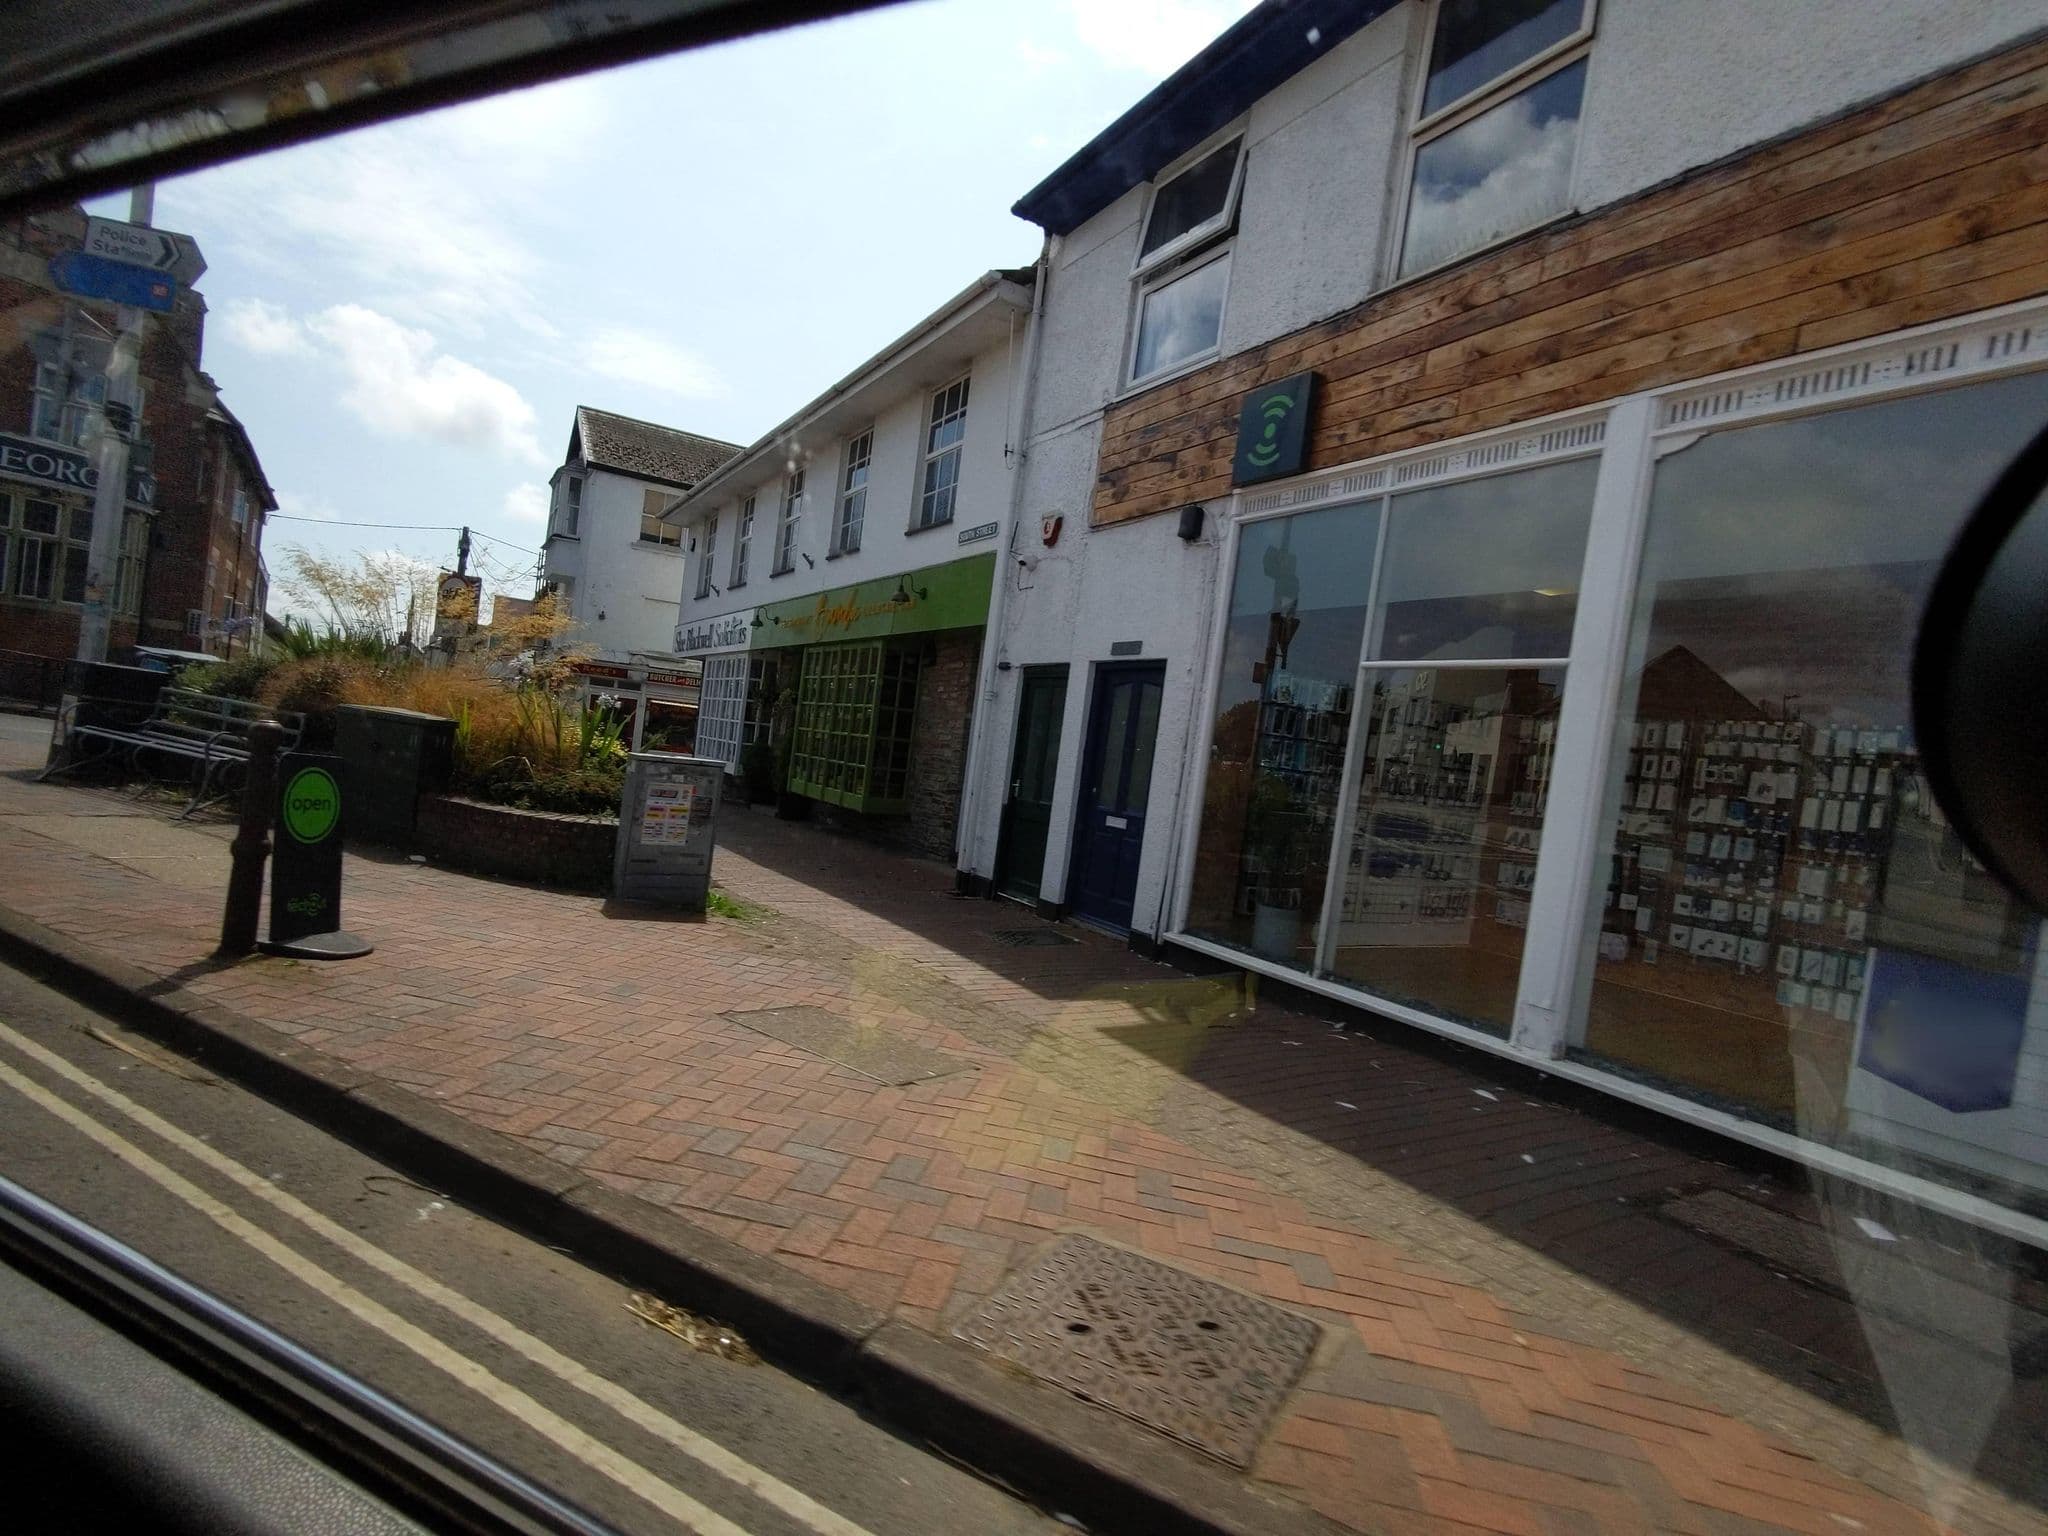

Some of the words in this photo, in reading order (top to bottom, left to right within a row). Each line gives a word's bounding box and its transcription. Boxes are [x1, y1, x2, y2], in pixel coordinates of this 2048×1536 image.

[100, 226, 146, 246] Police
[0, 446, 99, 487] EORG
[975, 525, 996, 537] STREET
[649, 674, 677, 683] BUTCHER
[293, 799, 330, 814] open
